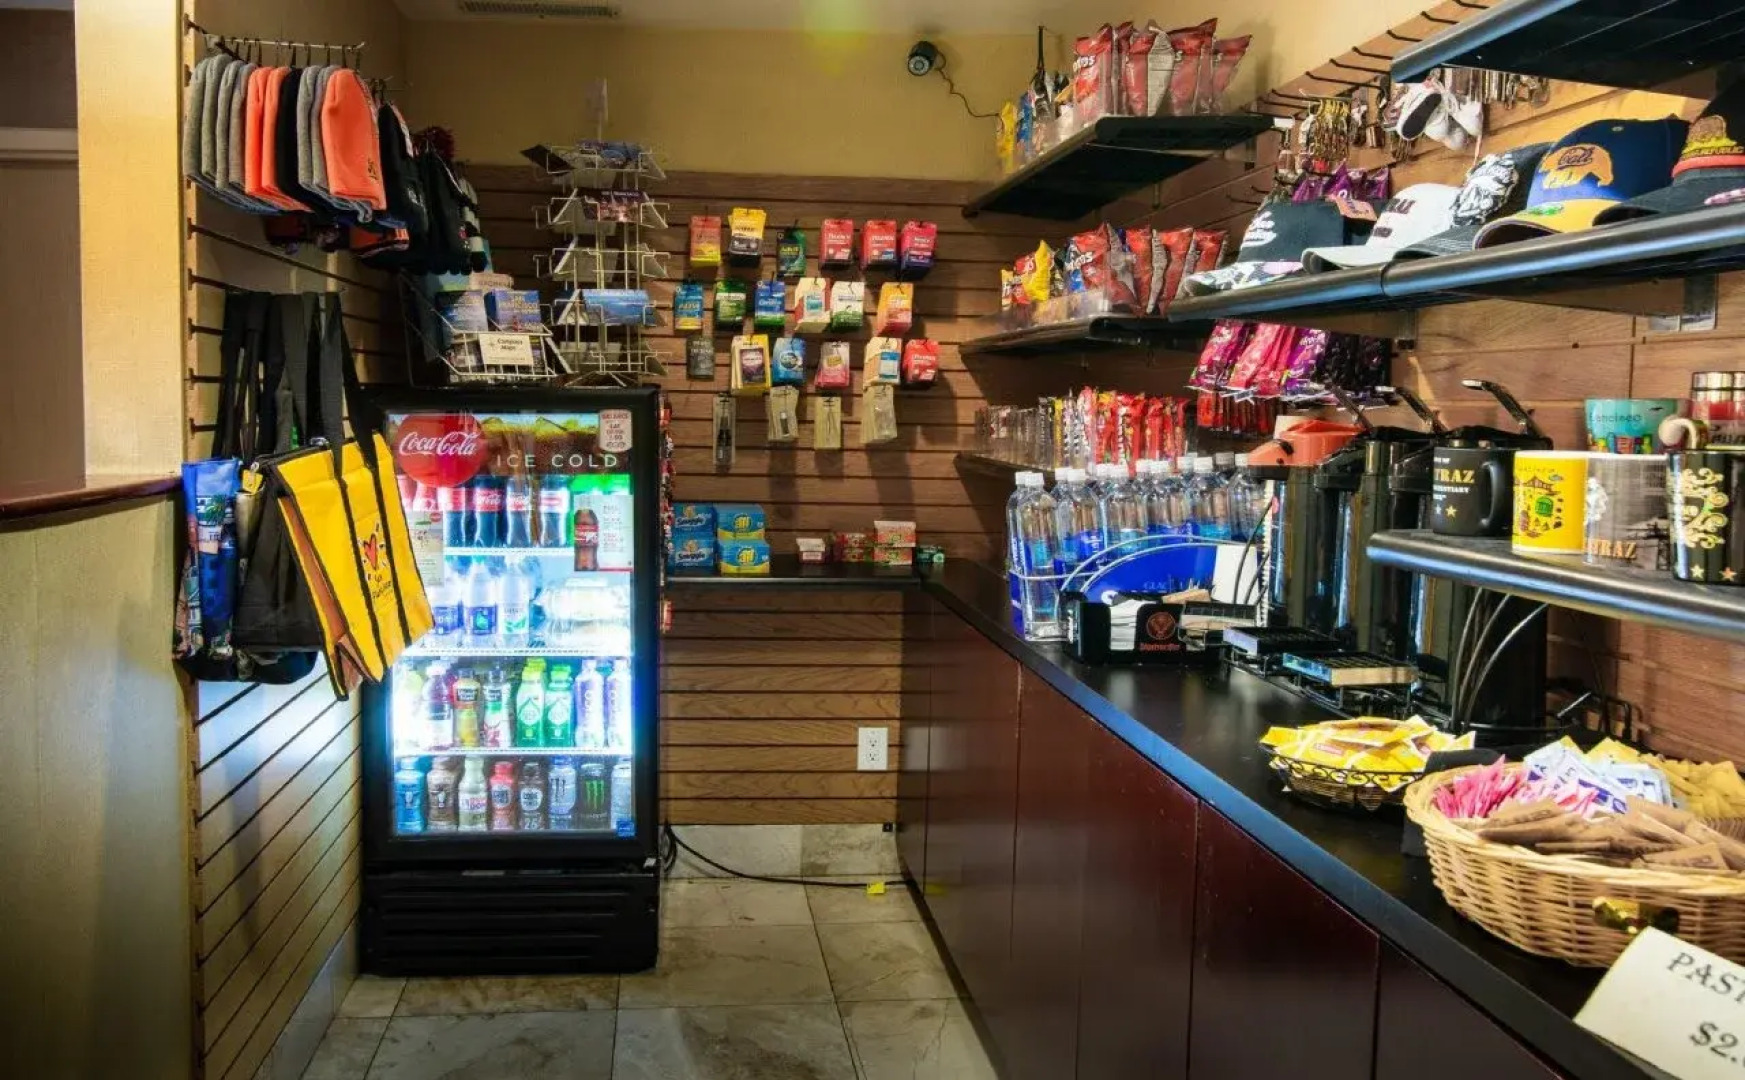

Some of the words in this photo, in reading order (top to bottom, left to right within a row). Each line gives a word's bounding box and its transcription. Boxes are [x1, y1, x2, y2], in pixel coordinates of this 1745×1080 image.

[400, 430, 482, 456] Coca-Cola
[497, 453, 537, 468] ICE
[551, 453, 618, 468] COLD
[1690, 1021, 1745, 1068] $2.
